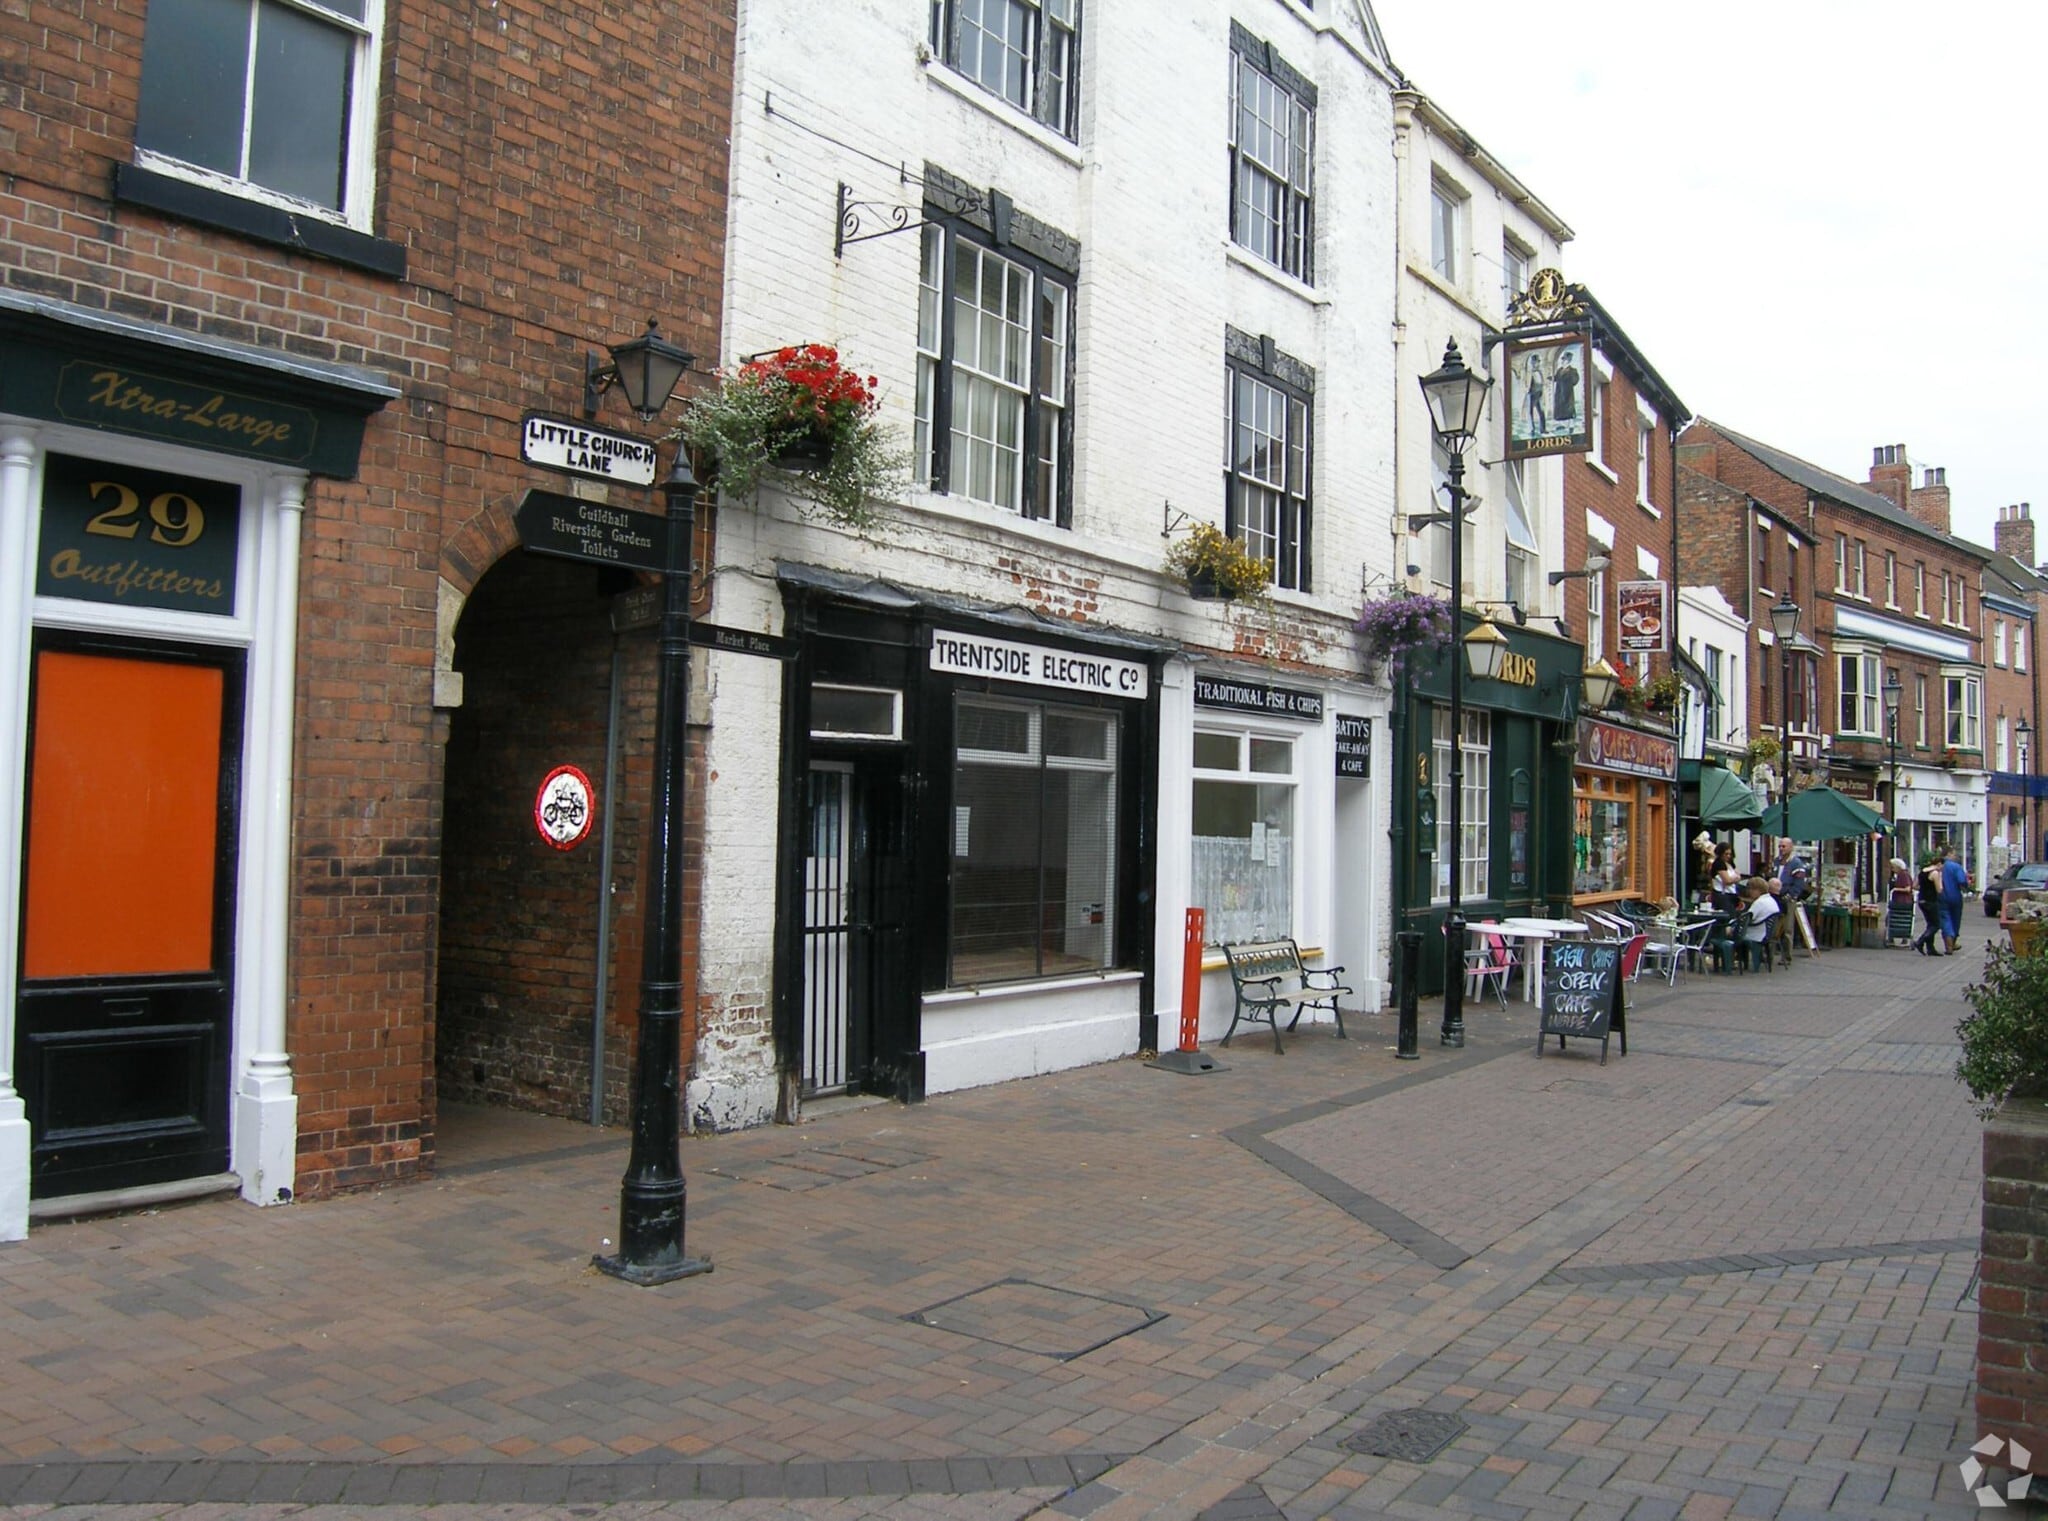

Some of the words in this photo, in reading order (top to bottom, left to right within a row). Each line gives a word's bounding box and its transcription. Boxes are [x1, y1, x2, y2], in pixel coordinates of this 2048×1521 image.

[88, 372, 291, 446] Xtra-Large
[529, 421, 589, 449] LITTLE
[591, 436, 654, 465] CHURCH
[1527, 436, 1572, 449] LORDS
[567, 448, 612, 474] LANE
[85, 481, 205, 547] 29
[579, 505, 629, 528] Guildhall
[552, 517, 603, 539] Riverside
[611, 529, 652, 548] Gardens
[581, 539, 619, 559] Toilets
[50, 548, 224, 599] Outfitters
[716, 631, 744, 648] Market
[749, 635, 770, 652] Place
[936, 639, 1030, 676] TRENTSIDE
[1043, 655, 1112, 688] ELECTRIC
[1197, 681, 1263, 706] TRADITIONAL
[1266, 691, 1287, 709] FISH
[1288, 695, 1295, 710] &
[1297, 696, 1321, 714] CHIPS
[1341, 759, 1346, 771] &
[1347, 760, 1363, 772] CAFE
[1559, 971, 1606, 990] OPEN
